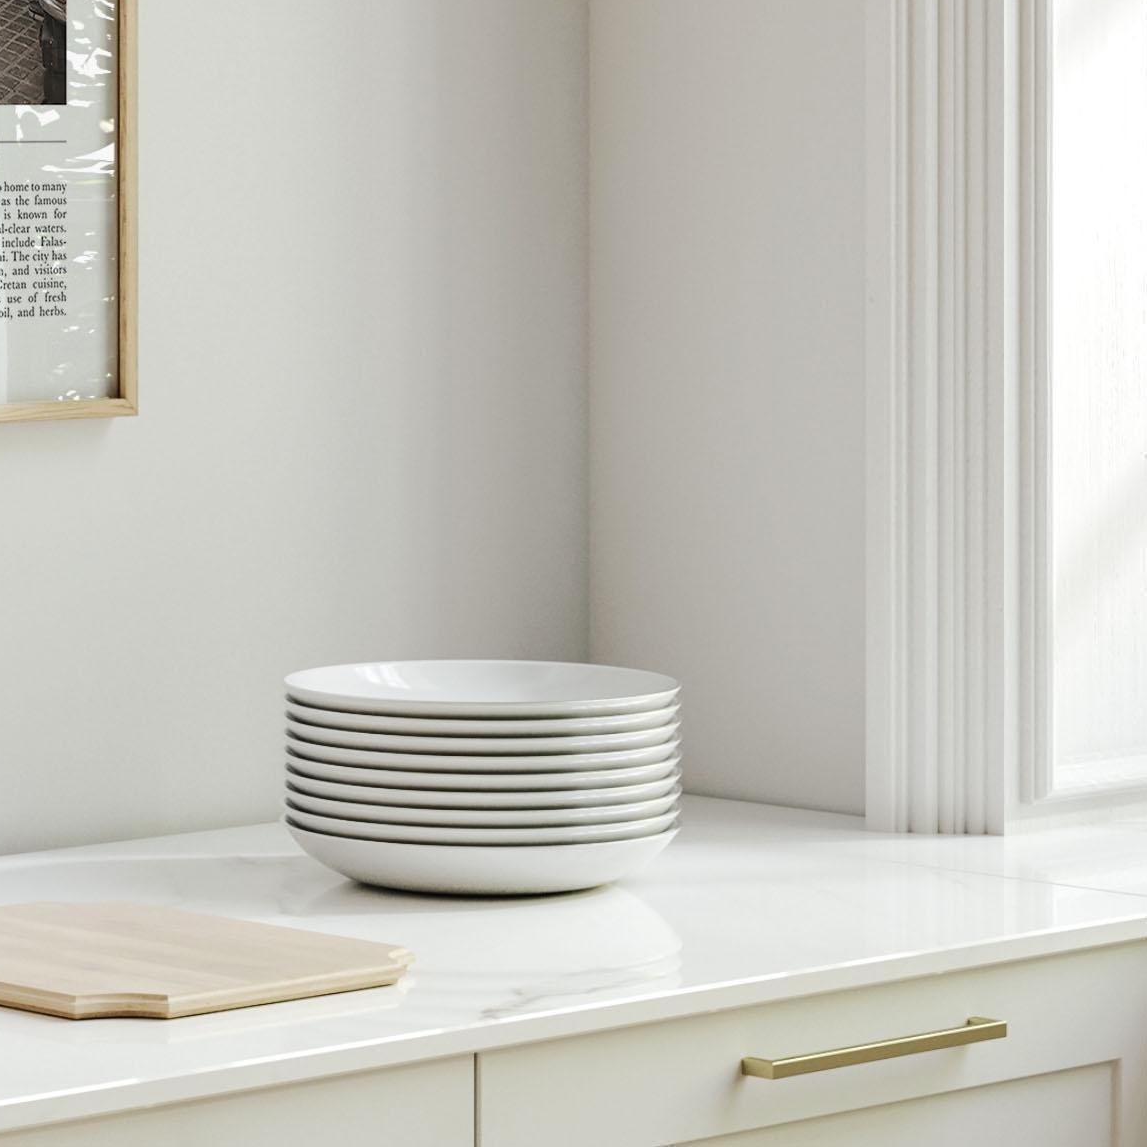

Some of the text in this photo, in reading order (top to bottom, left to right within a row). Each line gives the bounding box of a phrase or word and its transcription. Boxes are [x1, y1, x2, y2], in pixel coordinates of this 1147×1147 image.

[4, 181, 30, 192] home
[30, 183, 40, 191] to
[42, 184, 68, 194] many
[14, 195, 30, 206] the
[34, 193, 68, 205] famous
[4, 208, 12, 220] is
[18, 209, 48, 220] known
[54, 208, 68, 219] for
[34, 225, 66, 233] waters.
[2, 237, 36, 248] include
[40, 236, 66, 247] Falas-
[12, 264, 30, 276] and
[34, 263, 68, 275] visitors
[32, 278, 66, 292] cuisine,
[16, 306, 34, 317] and
[38, 305, 66, 316] herbs.
